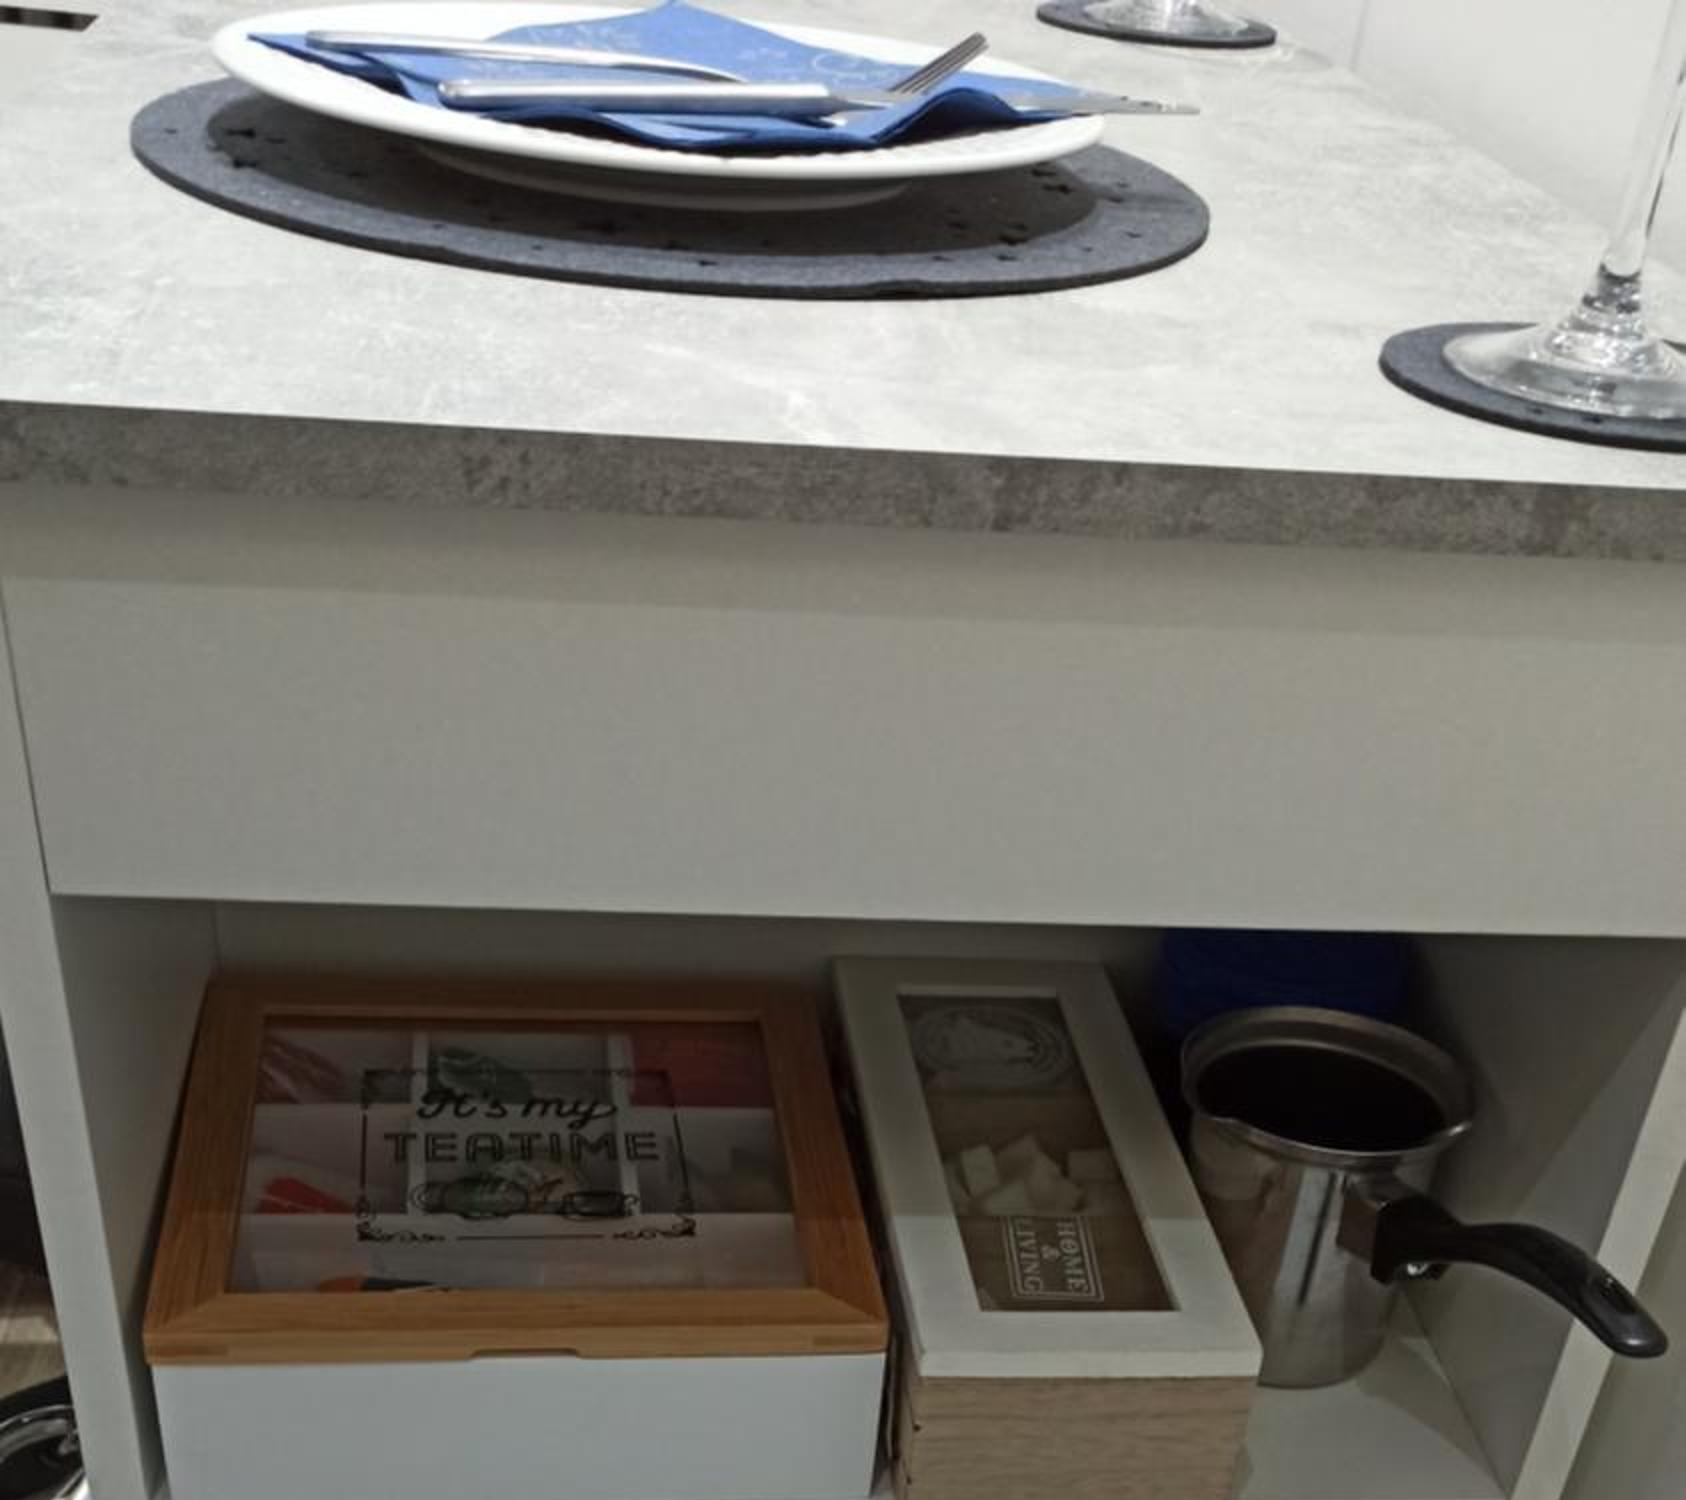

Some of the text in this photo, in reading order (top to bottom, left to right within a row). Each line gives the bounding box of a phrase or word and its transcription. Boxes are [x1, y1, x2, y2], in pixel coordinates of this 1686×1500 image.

[416, 1087, 618, 1131] It's my
[383, 1131, 660, 1163] TEATIME
[1015, 1217, 1044, 1293] LIVING
[1056, 1219, 1089, 1293] HOME
